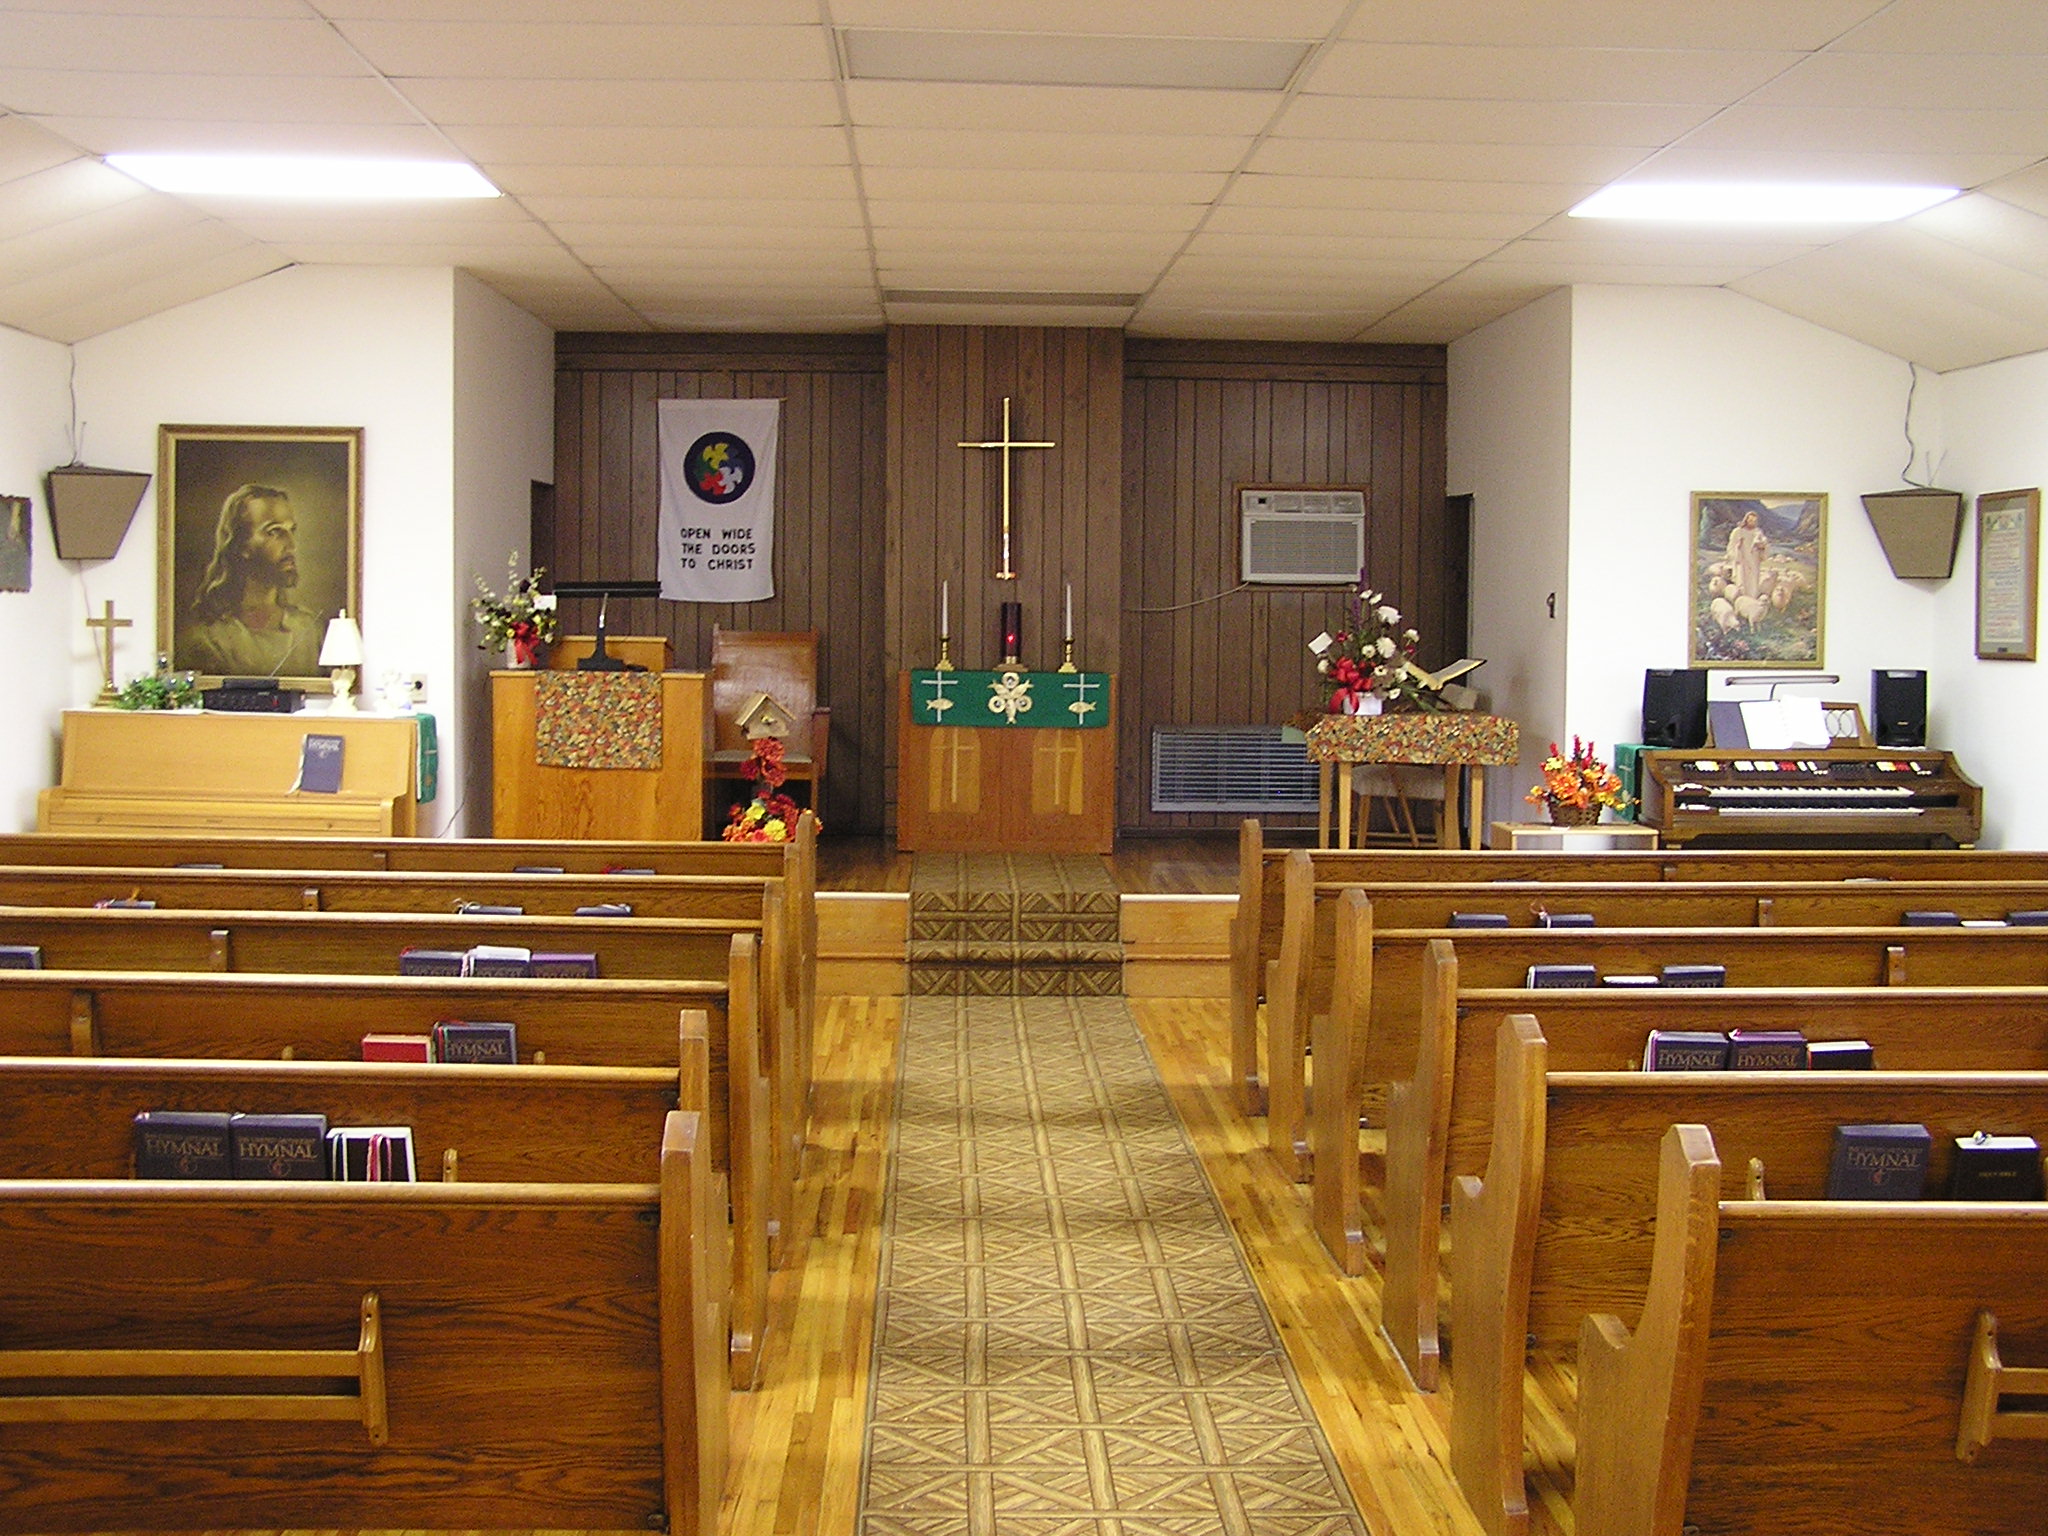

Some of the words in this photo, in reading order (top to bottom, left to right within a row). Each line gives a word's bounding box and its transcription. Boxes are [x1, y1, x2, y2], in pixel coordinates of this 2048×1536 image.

[680, 528, 711, 539] OPEN
[722, 528, 753, 539] WIDE
[682, 543, 702, 554] THE
[712, 543, 755, 554] DOORS
[681, 558, 696, 568] TO
[708, 559, 753, 570] CHRIST
[1658, 1053, 1721, 1066] HYMNAL
[1737, 1055, 1798, 1067] HYMNAL
[146, 1139, 224, 1157] HYMNAL
[239, 1143, 318, 1158] HYMNAL
[1849, 1152, 1921, 1167] HYMNAL
